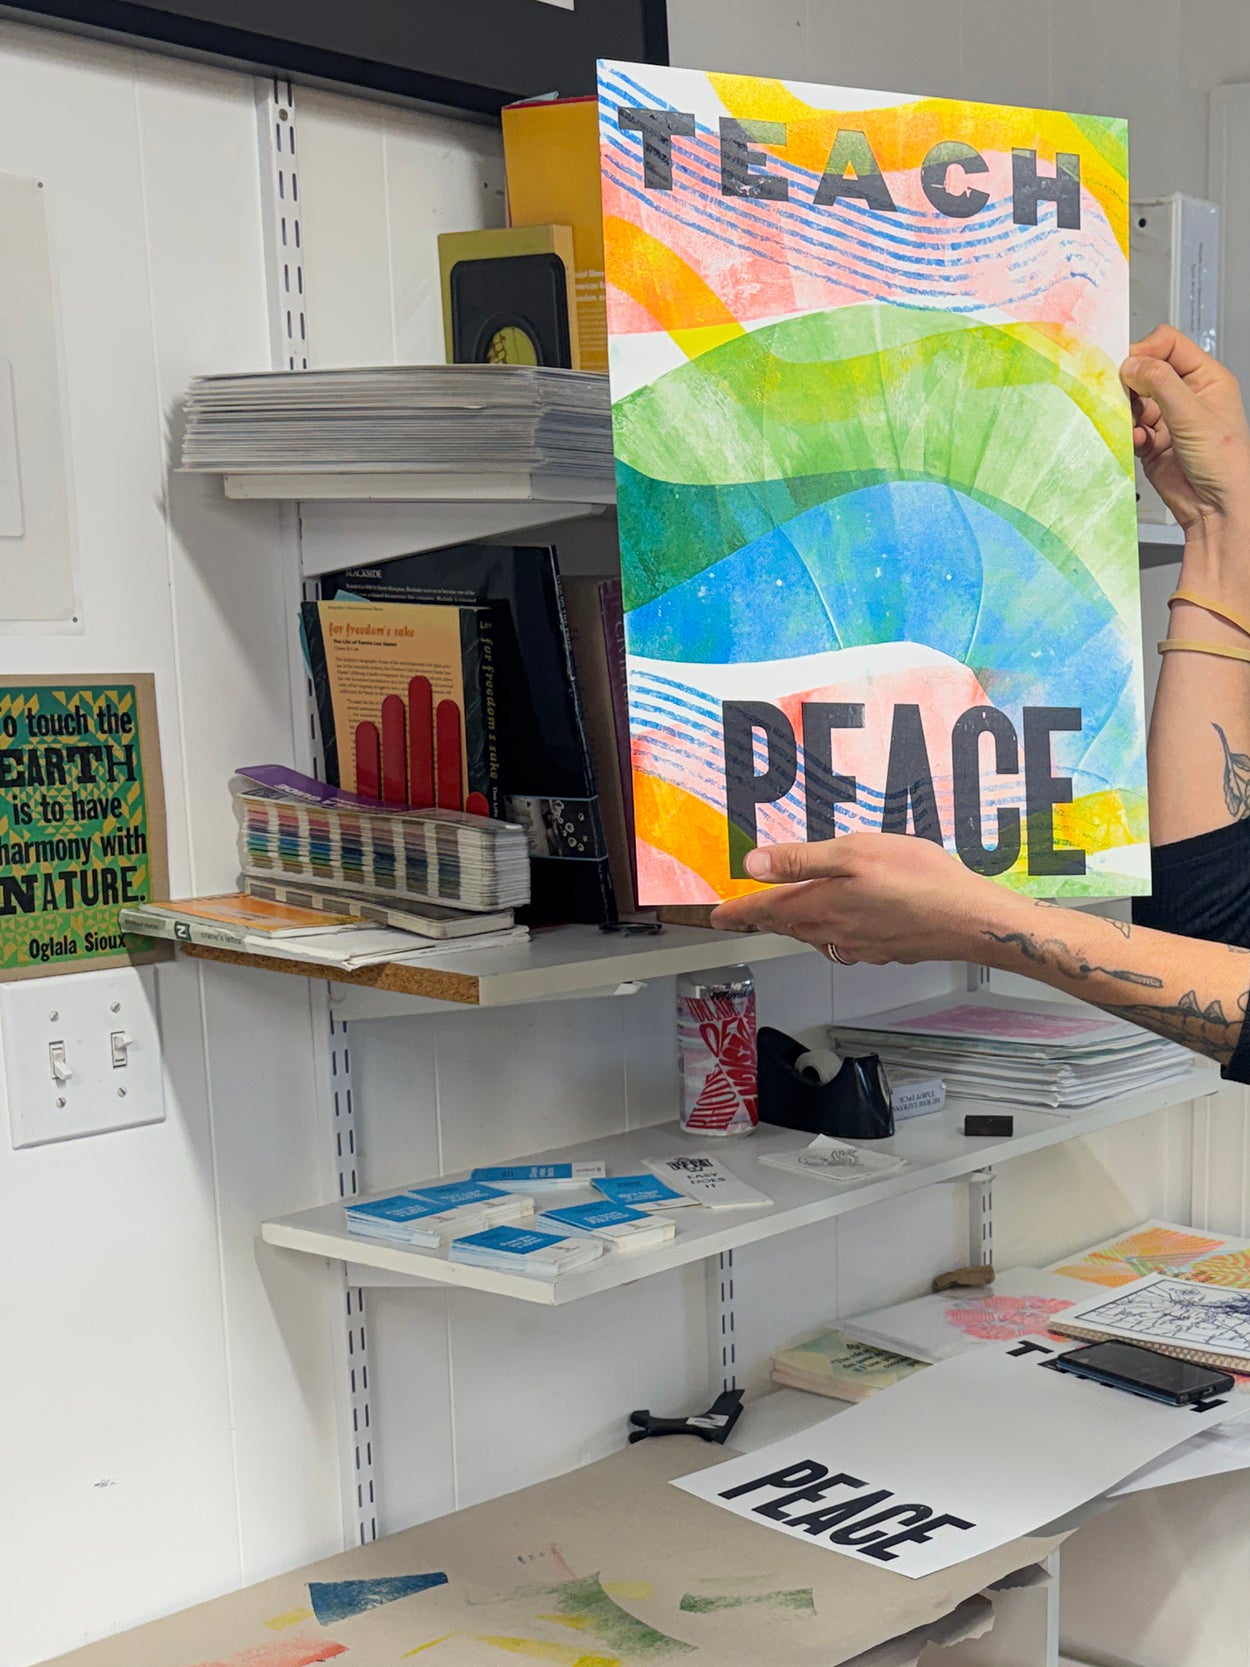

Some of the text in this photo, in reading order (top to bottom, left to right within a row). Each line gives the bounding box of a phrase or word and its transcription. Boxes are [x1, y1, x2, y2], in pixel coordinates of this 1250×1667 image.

[617, 106, 1081, 230] TEACH
[329, 622, 344, 637] for
[394, 626, 415, 638] sake
[0, 702, 133, 738] o touch the
[481, 636, 493, 663] for
[489, 744, 500, 780] sake
[0, 744, 138, 788] EARTH
[12, 790, 122, 825] is to have
[722, 700, 1087, 878] PEACE
[0, 826, 147, 866] harmony with
[0, 865, 146, 916] NATURE.
[29, 931, 126, 962] Oglala Sioux
[717, 1458, 977, 1562] PEACE
